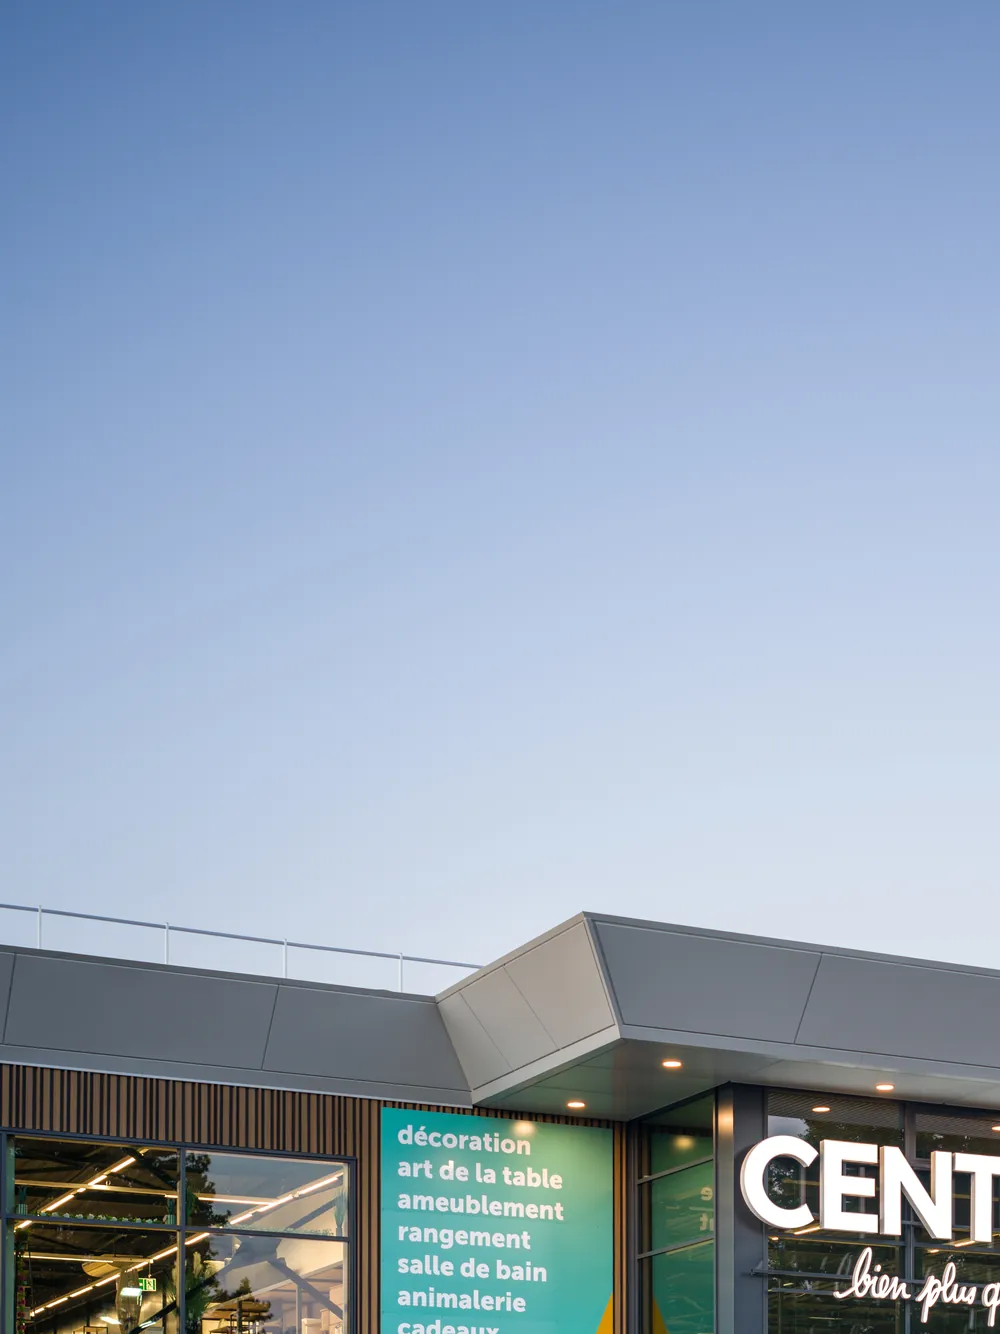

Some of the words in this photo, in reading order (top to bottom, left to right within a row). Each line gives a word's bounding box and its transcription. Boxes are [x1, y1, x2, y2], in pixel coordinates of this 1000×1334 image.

[397, 1125, 531, 1155] décoration
[397, 1161, 433, 1179] art
[439, 1160, 469, 1182] de
[475, 1163, 496, 1184] la
[502, 1166, 563, 1190] table
[397, 1193, 564, 1221] ameublement
[398, 1225, 531, 1250] rangement
[397, 1255, 454, 1276] salle
[460, 1258, 489, 1279] de
[496, 1259, 547, 1282] bain
[833, 1247, 911, 1300] bien
[915, 1262, 977, 1324] plus
[397, 1287, 527, 1313] animalerie
